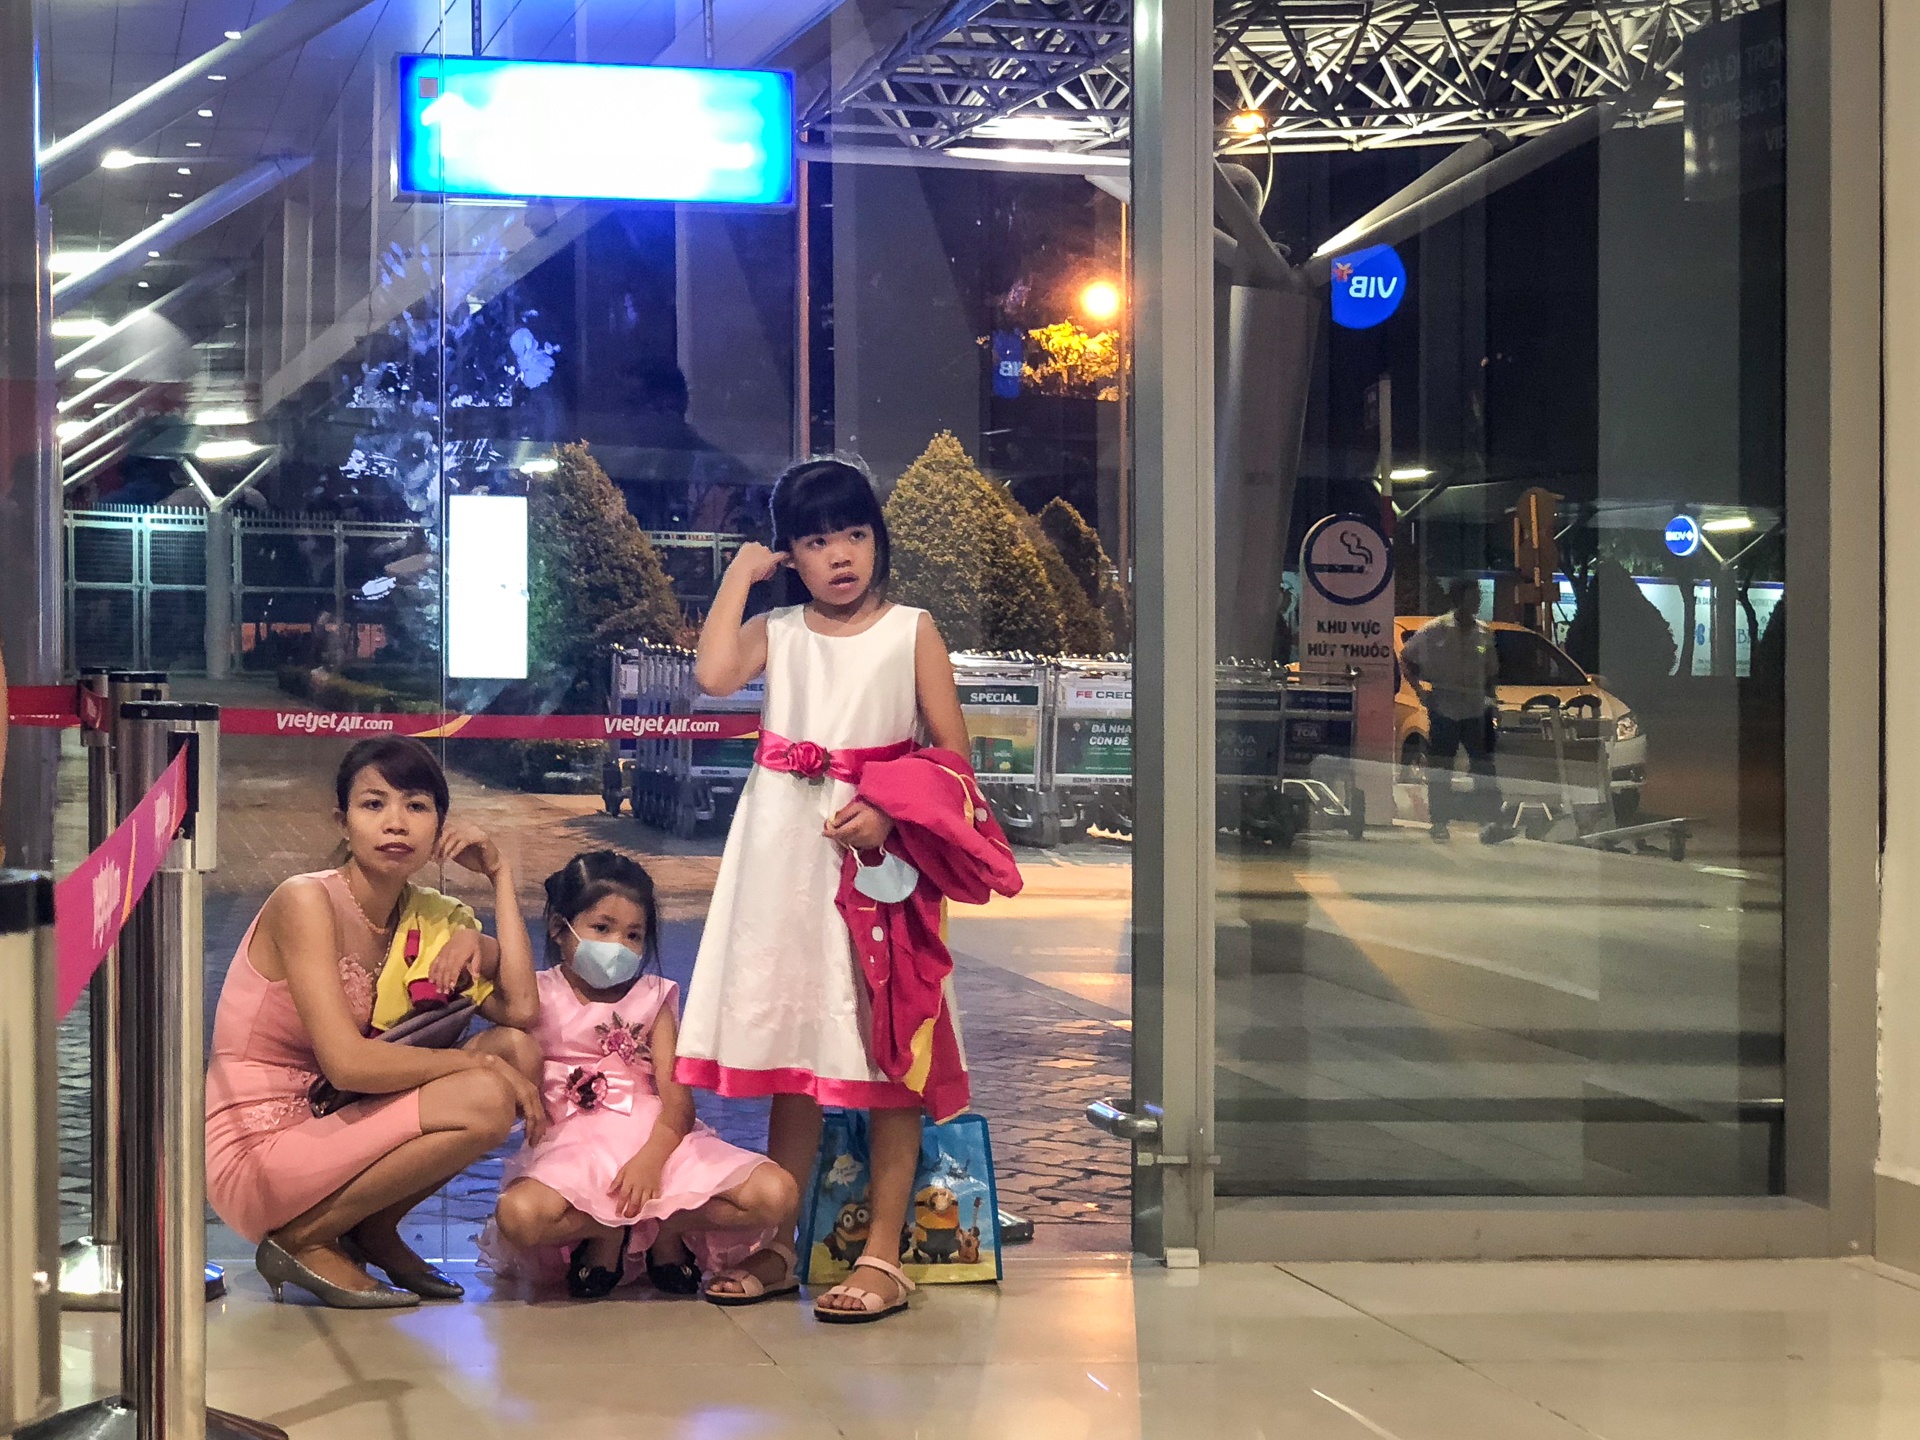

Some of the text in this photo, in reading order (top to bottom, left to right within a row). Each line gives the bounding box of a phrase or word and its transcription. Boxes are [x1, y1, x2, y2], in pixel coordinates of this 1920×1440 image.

[1316, 619, 1381, 639] KHU VỰC
[1307, 641, 1337, 657] HÚT
[970, 692, 1021, 703] SPECIAL
[1076, 691, 1092, 699] FE
